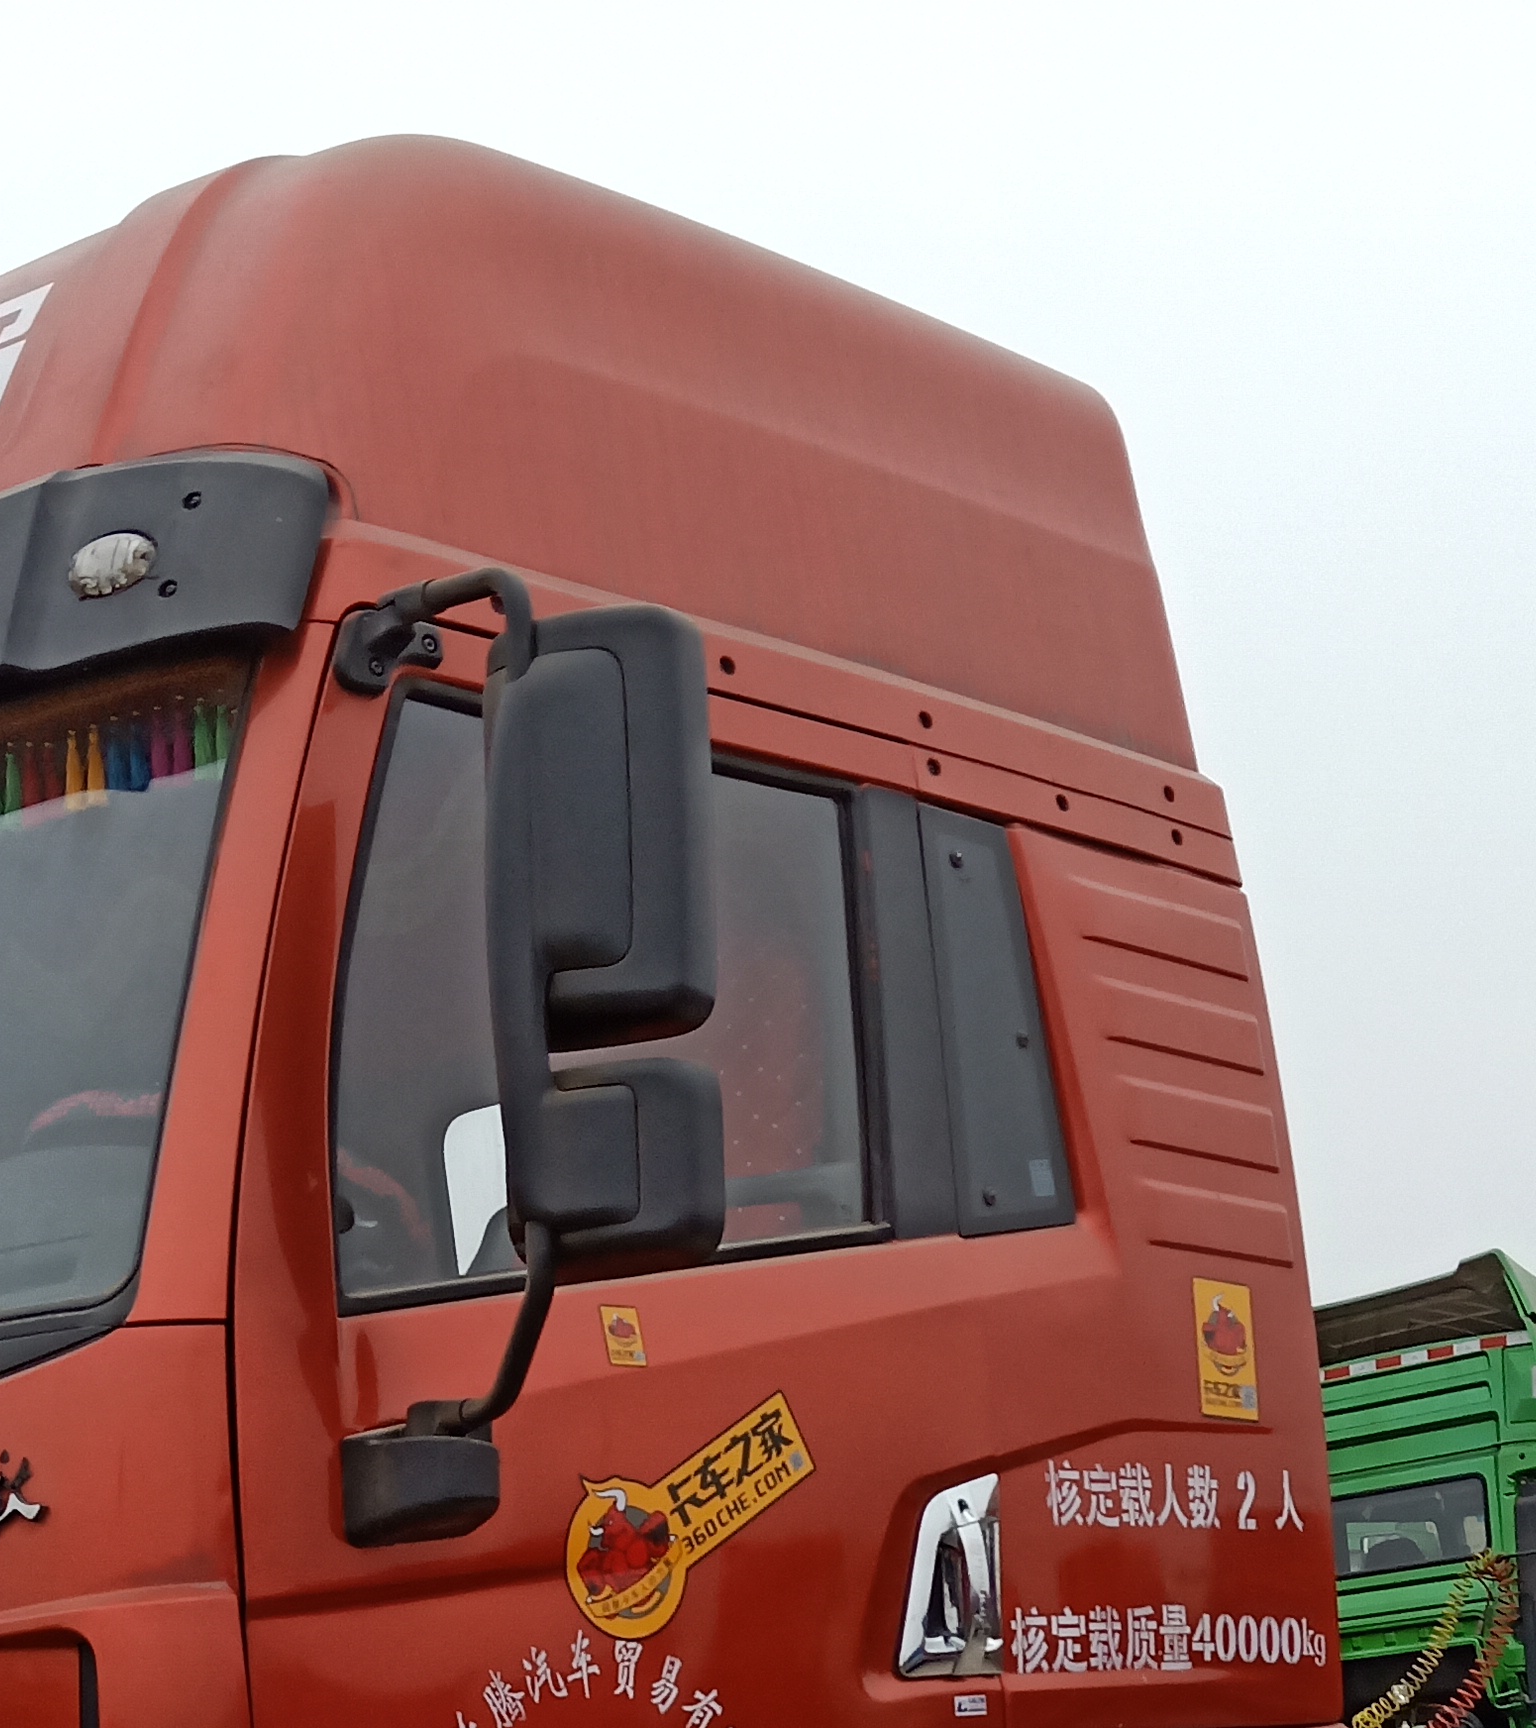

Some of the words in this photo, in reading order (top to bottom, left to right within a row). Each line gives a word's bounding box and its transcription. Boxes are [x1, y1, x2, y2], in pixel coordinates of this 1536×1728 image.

[667, 1408, 793, 1527] 卡车之家
[682, 1461, 791, 1554] 360CHE.COM
[1044, 1459, 1221, 1529] 核定载人数
[1237, 1471, 1258, 1530] 2
[1275, 1470, 1304, 1532] 人
[1011, 1604, 1326, 1674] 核定载质量40000kg
